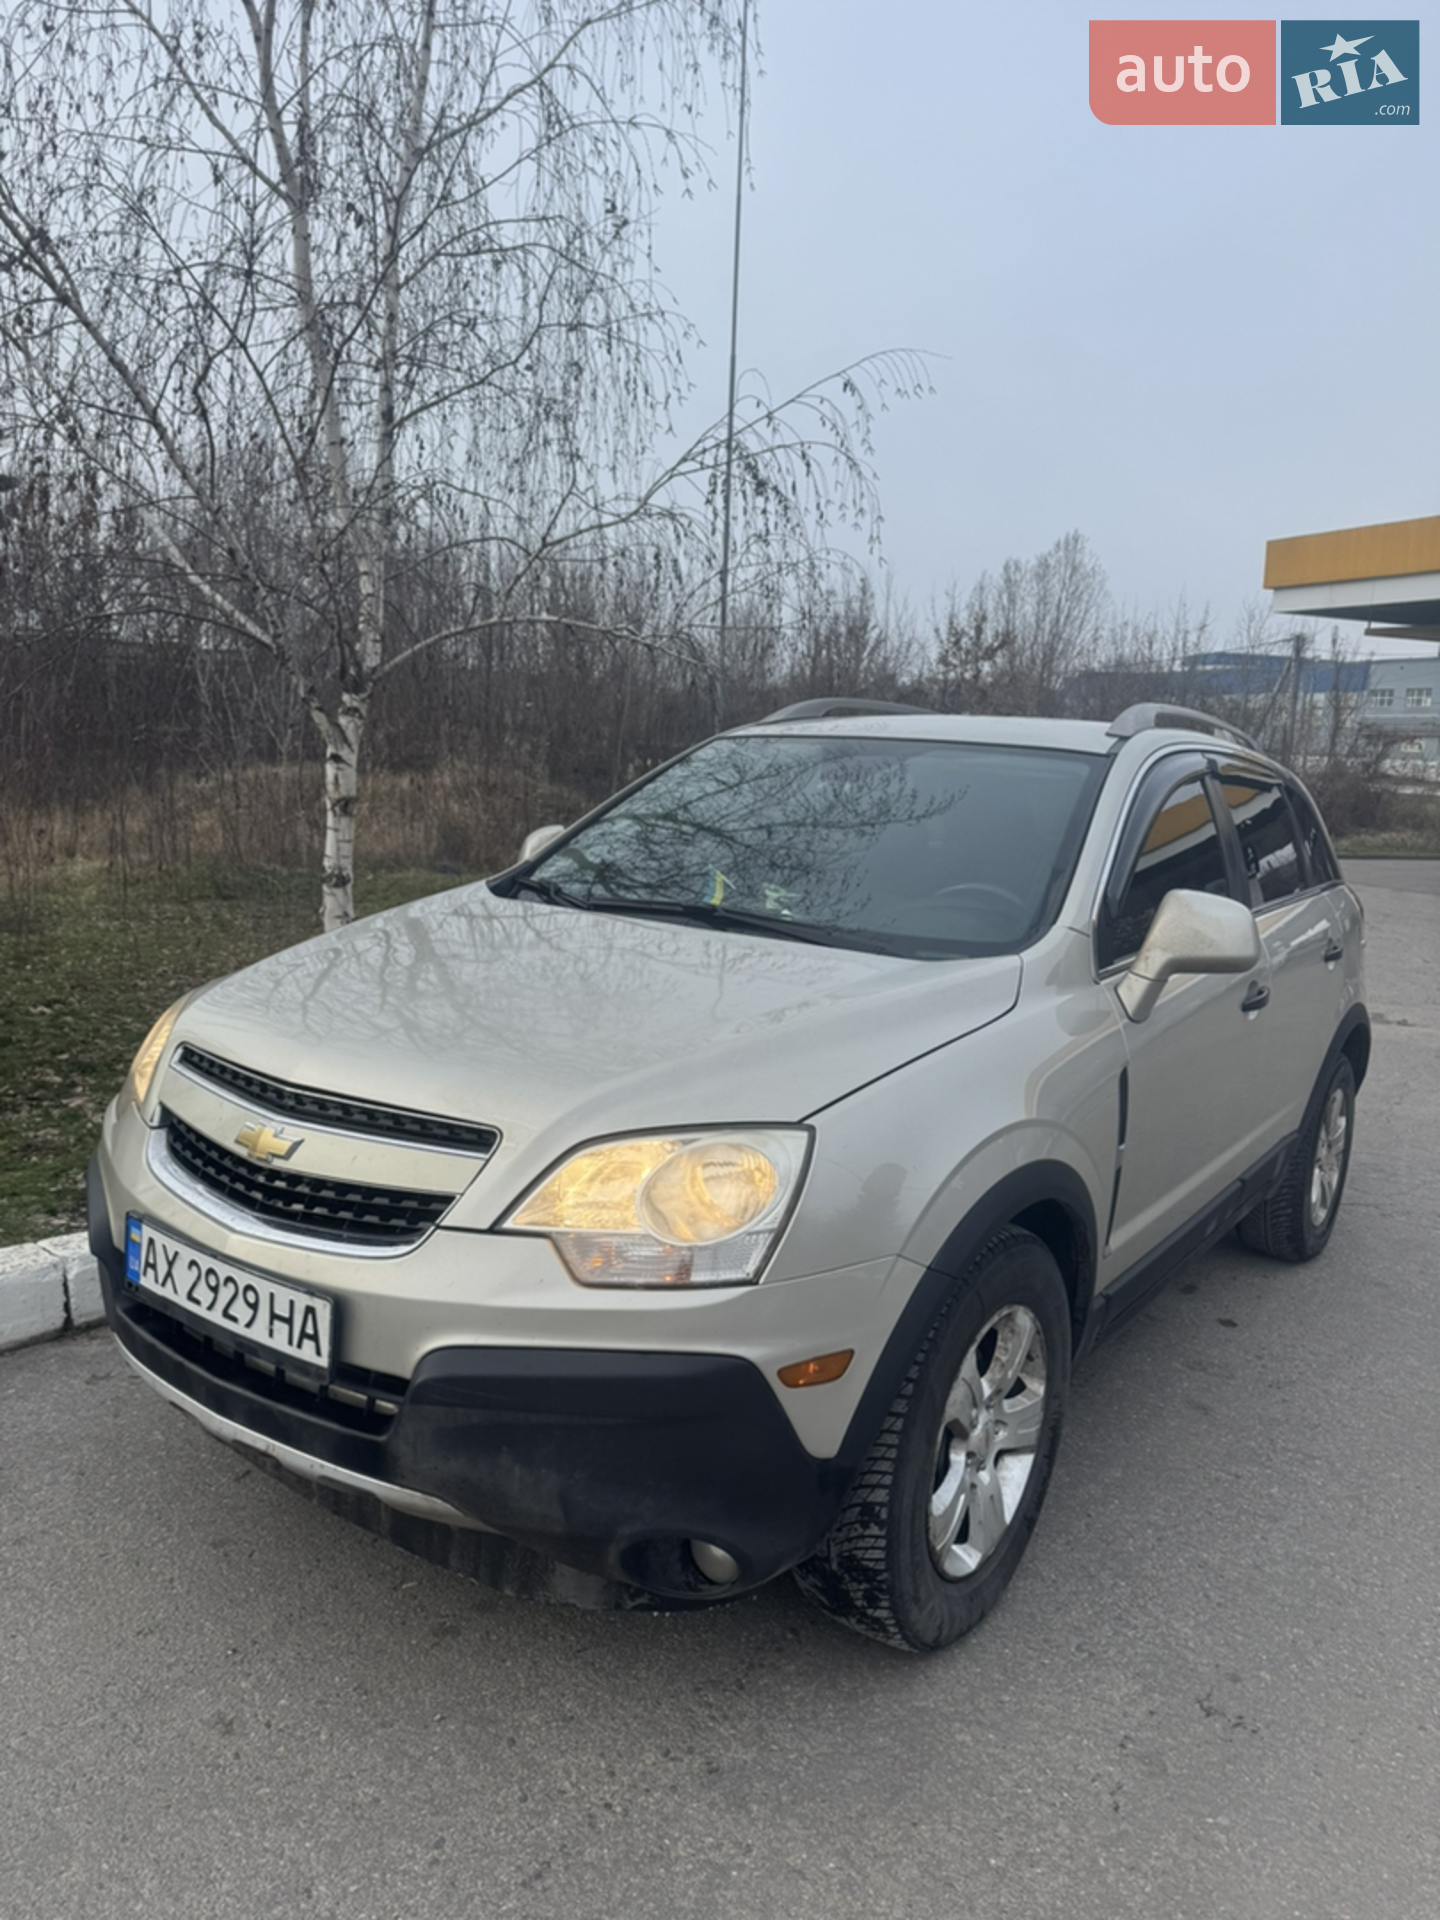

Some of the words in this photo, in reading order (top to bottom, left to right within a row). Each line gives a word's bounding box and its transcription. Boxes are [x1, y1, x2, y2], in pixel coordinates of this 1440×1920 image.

[142, 1236, 180, 1296] AX
[186, 1259, 260, 1329] 2929
[268, 1292, 322, 1358] HA
